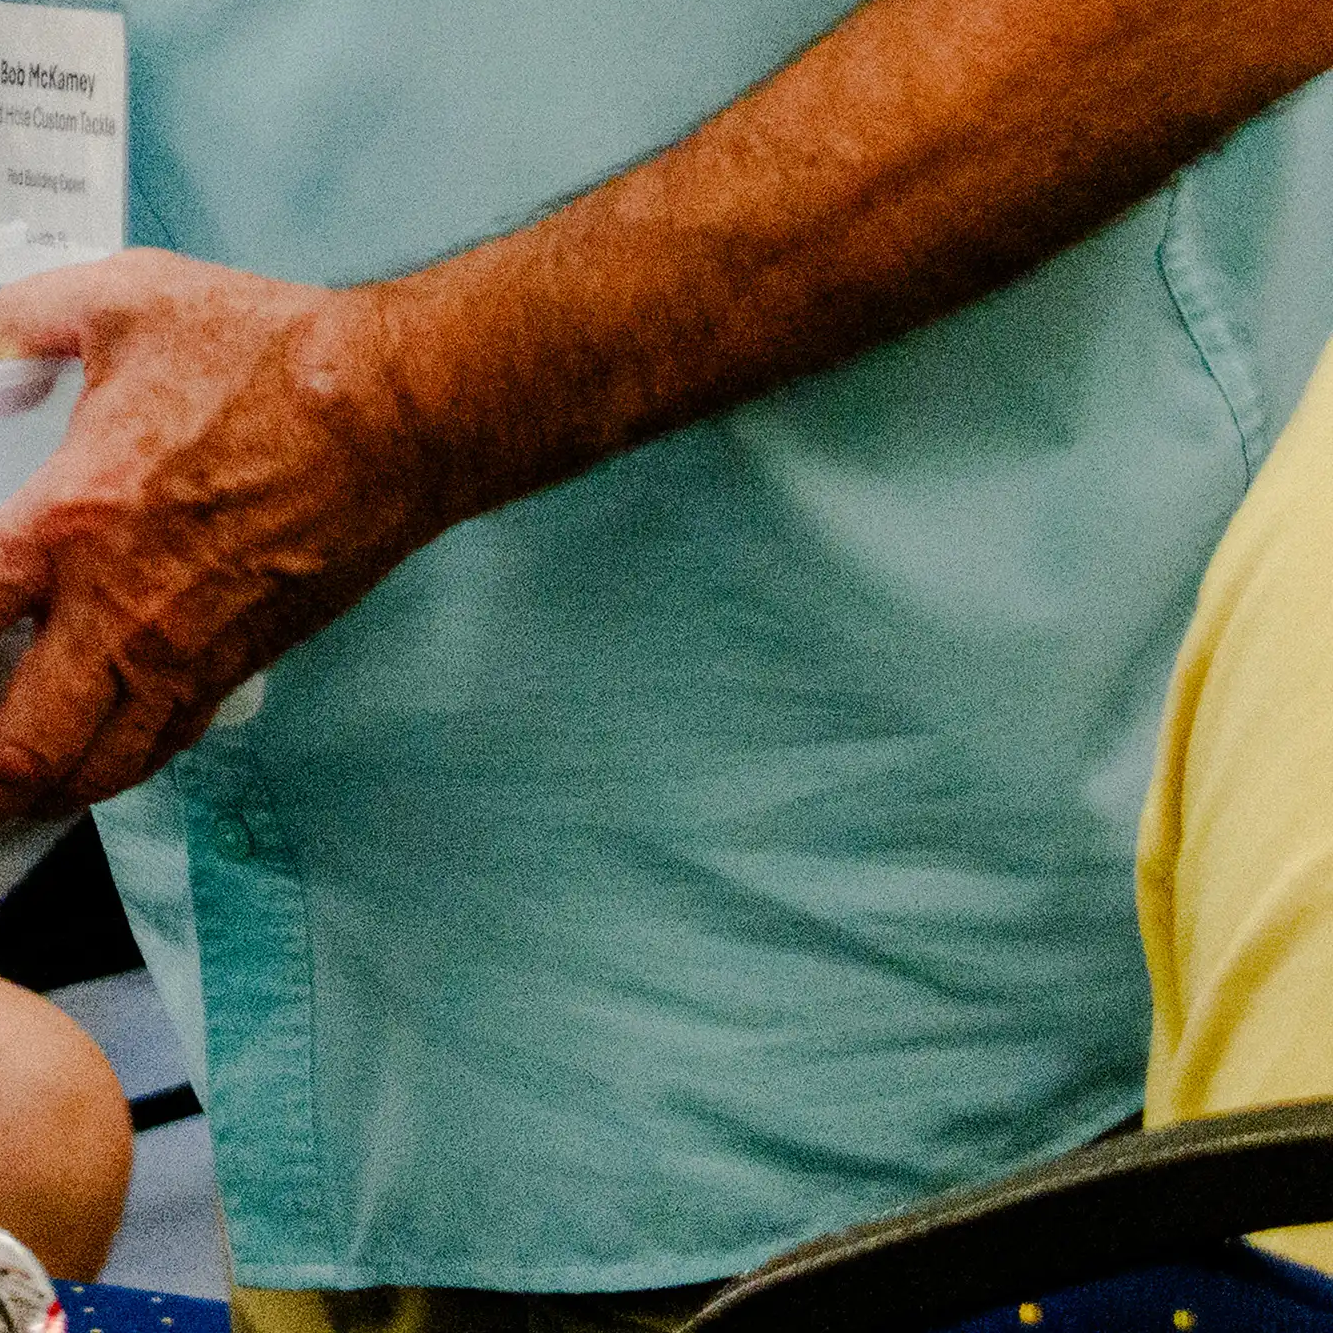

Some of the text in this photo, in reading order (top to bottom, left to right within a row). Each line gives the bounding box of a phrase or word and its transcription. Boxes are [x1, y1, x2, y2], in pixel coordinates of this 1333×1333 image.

[1, 60, 96, 99] Bob McKamey
[32, 108, 78, 133] Custom
[80, 112, 117, 136] Tackle
